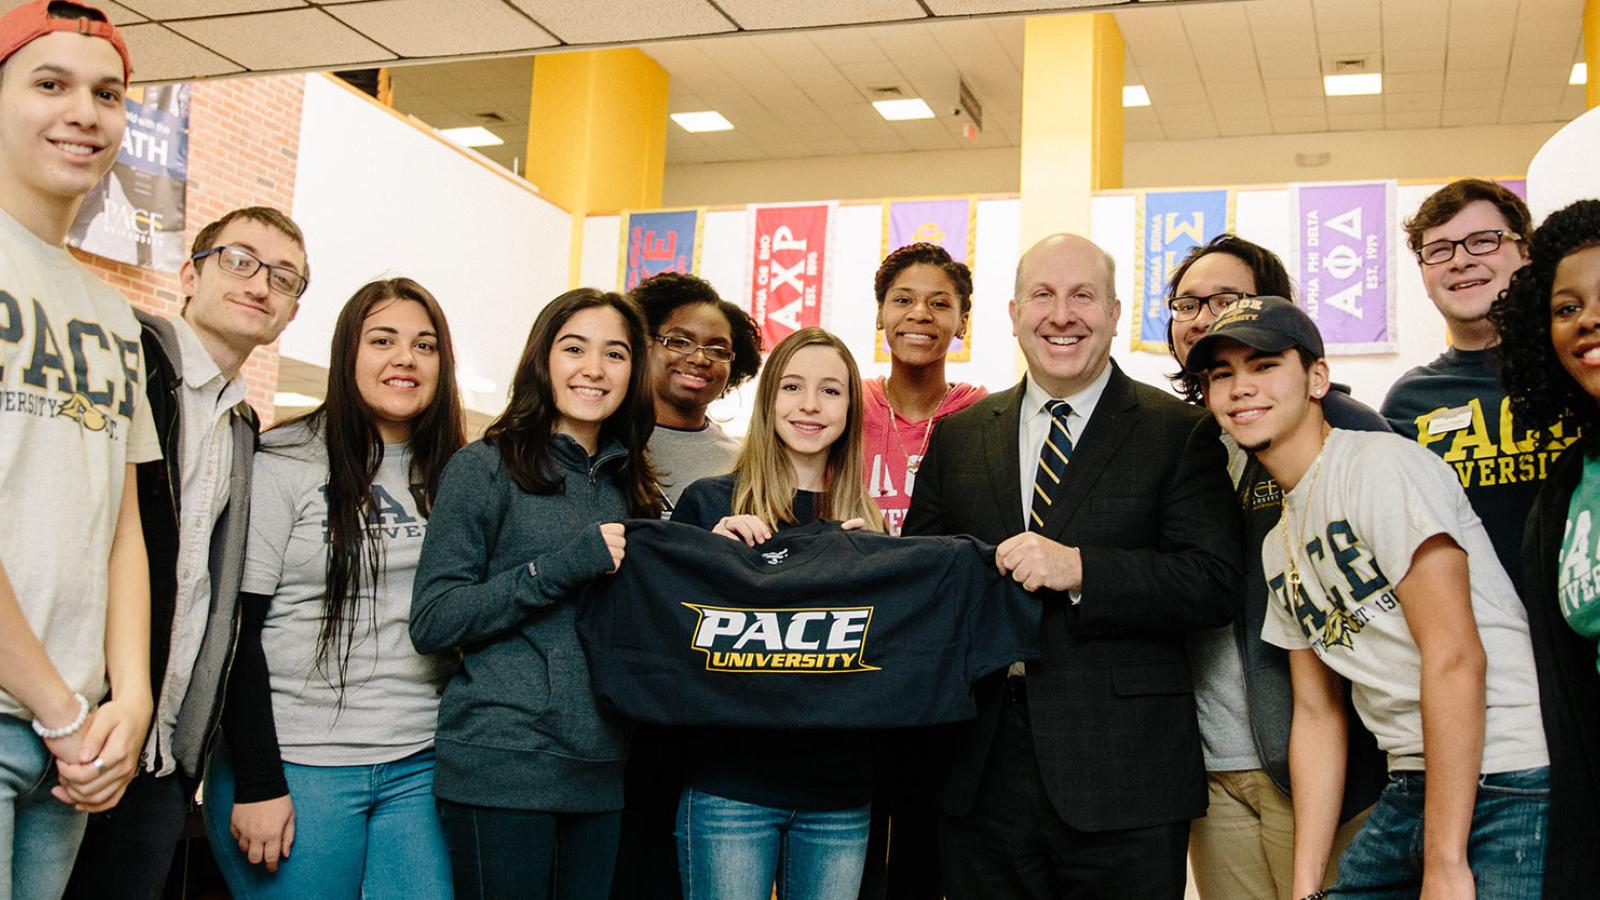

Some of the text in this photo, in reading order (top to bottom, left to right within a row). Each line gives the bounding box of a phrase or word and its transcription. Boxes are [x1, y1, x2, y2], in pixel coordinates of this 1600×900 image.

[120, 126, 168, 166] ATH
[1306, 209, 1320, 320] ALPHA PHI DELTA
[1365, 265, 1379, 290] EST.
[0, 390, 58, 418] ERSITY
[1253, 479, 1280, 498] CE
[1454, 451, 1562, 489] VERSI
[1350, 588, 1400, 629] ST. 19
[695, 608, 870, 651] PACE
[712, 652, 858, 669] UNIVERSITY
